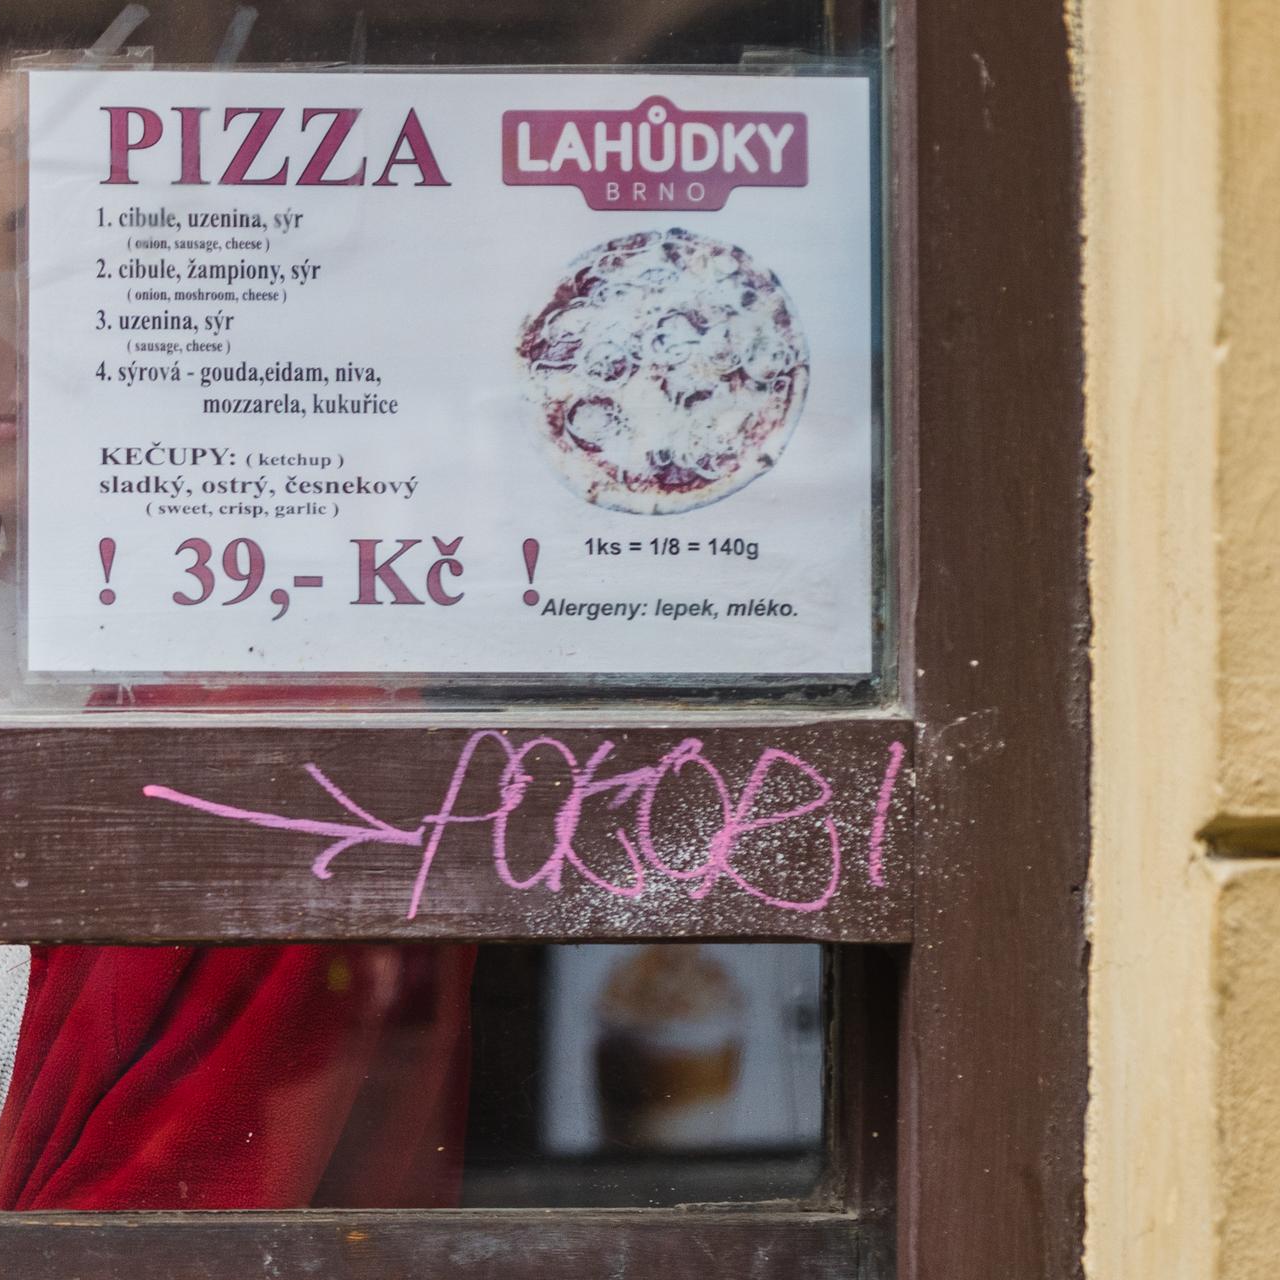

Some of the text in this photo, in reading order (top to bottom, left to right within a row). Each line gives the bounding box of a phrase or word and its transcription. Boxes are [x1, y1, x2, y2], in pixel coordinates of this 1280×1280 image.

[98, 105, 453, 188] PIZZA
[517, 105, 795, 174] LAHŮDKY
[606, 181, 705, 202] BRNO
[97, 206, 304, 234] 1. cibule, uzenina, sýr
[135, 237, 171, 251] onion,
[174, 238, 221, 253] sausage,
[225, 237, 263, 250] cheese
[96, 258, 322, 285] 2. cibule, žampiony, sýr
[135, 289, 171, 303] onion,
[174, 288, 239, 303] moshroom,
[242, 288, 280, 302] cheese
[96, 309, 235, 336] 3. uzenina, sýr
[135, 340, 183, 355] sausage,
[186, 339, 223, 353] cheese
[95, 360, 112, 382] 4.
[118, 360, 181, 387] sýrová
[200, 361, 330, 387] gouda,eidam,
[335, 361, 382, 387] niva,
[203, 392, 399, 419] mozzarela, kukuřice
[100, 441, 236, 466] KEČUPY:
[259, 453, 331, 469] ketchup
[100, 475, 419, 500] sladký, ostrý, česnekový
[158, 503, 213, 517] sweet,
[218, 502, 269, 518] crisp,
[275, 501, 327, 518] garlic
[584, 537, 623, 556] 1ks
[649, 537, 681, 556] 1/8
[707, 537, 760, 561] 140g
[172, 536, 324, 622] 39,-
[349, 535, 466, 607] Kč
[540, 598, 799, 622] Alergeny: lepek, mléko.
